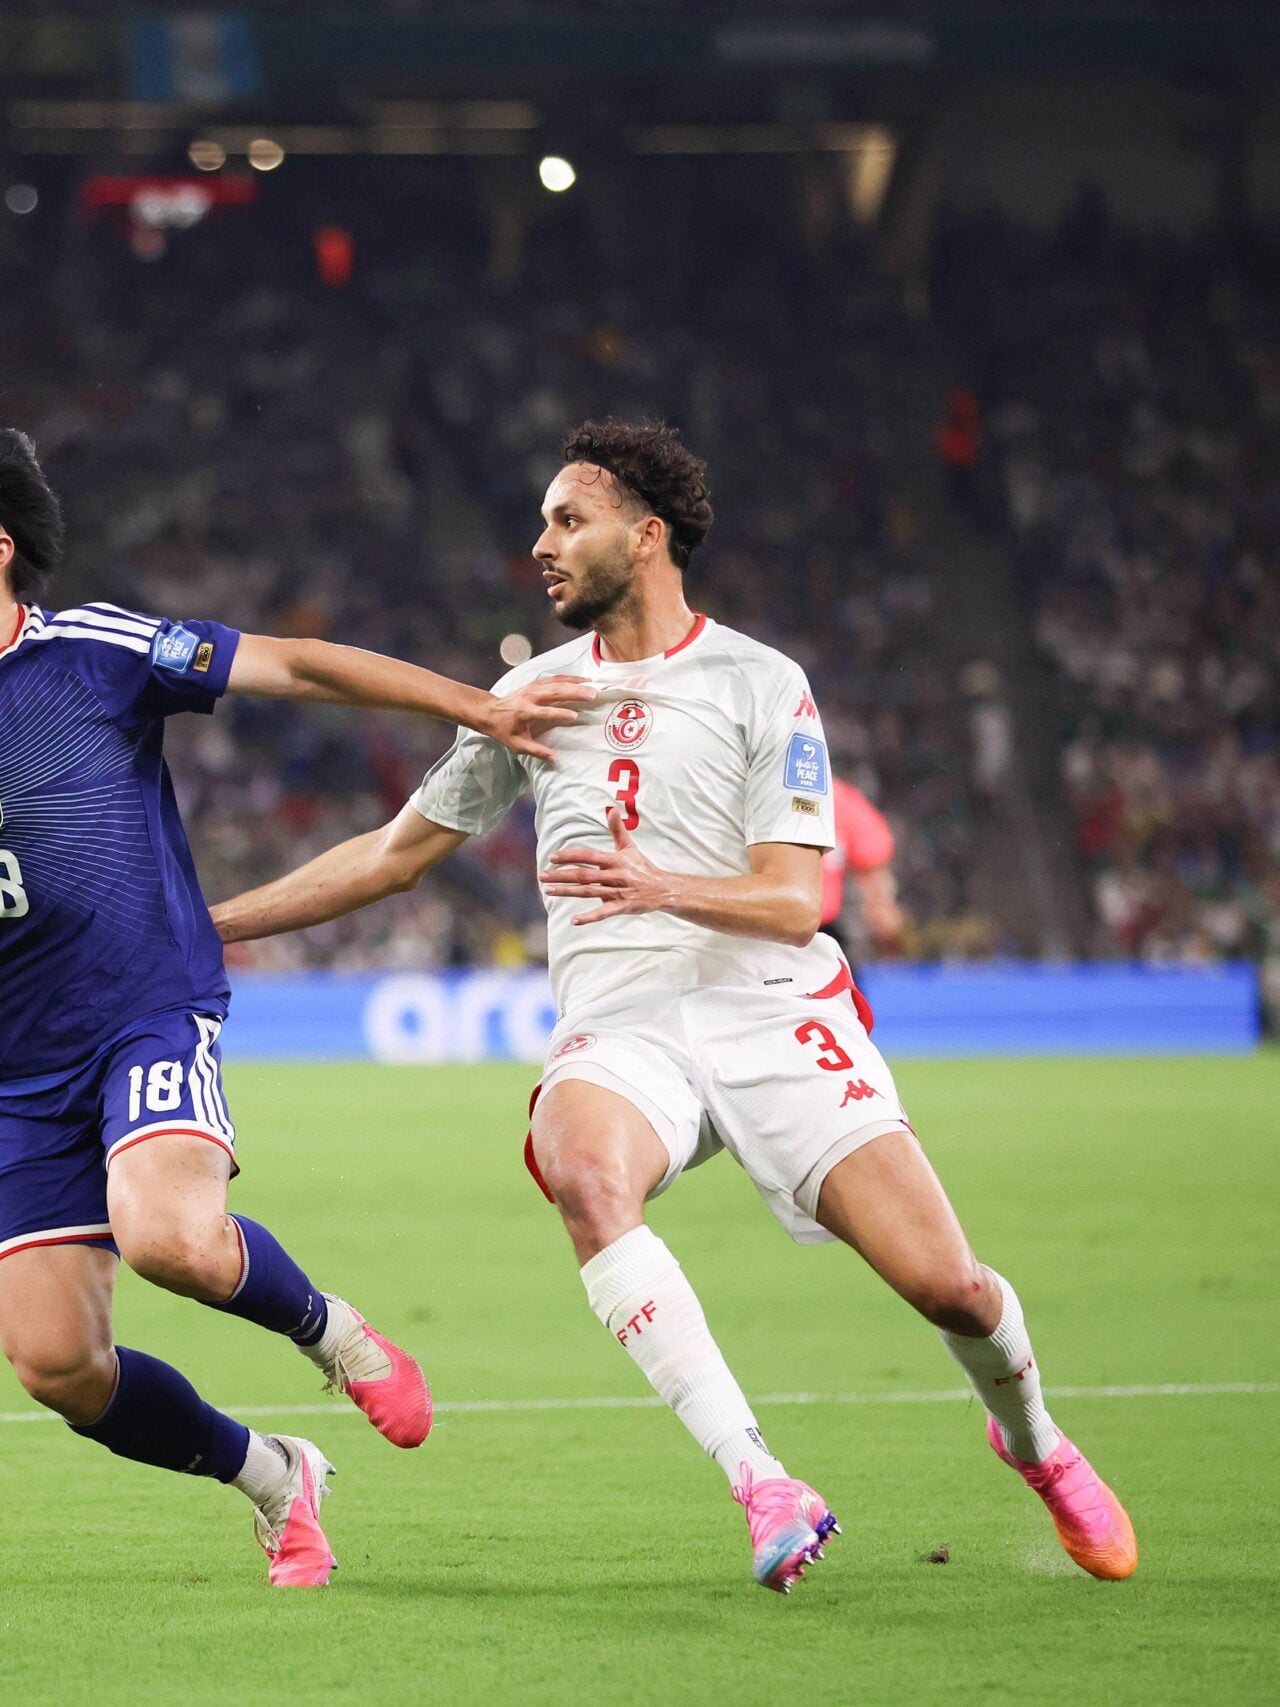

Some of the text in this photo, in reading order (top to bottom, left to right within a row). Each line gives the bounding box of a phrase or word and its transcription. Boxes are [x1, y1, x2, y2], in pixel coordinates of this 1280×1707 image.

[605, 759, 640, 831] 3
[794, 1020, 854, 1071] 3
[128, 1060, 183, 1122] 18
[616, 1300, 656, 1347] FTF
